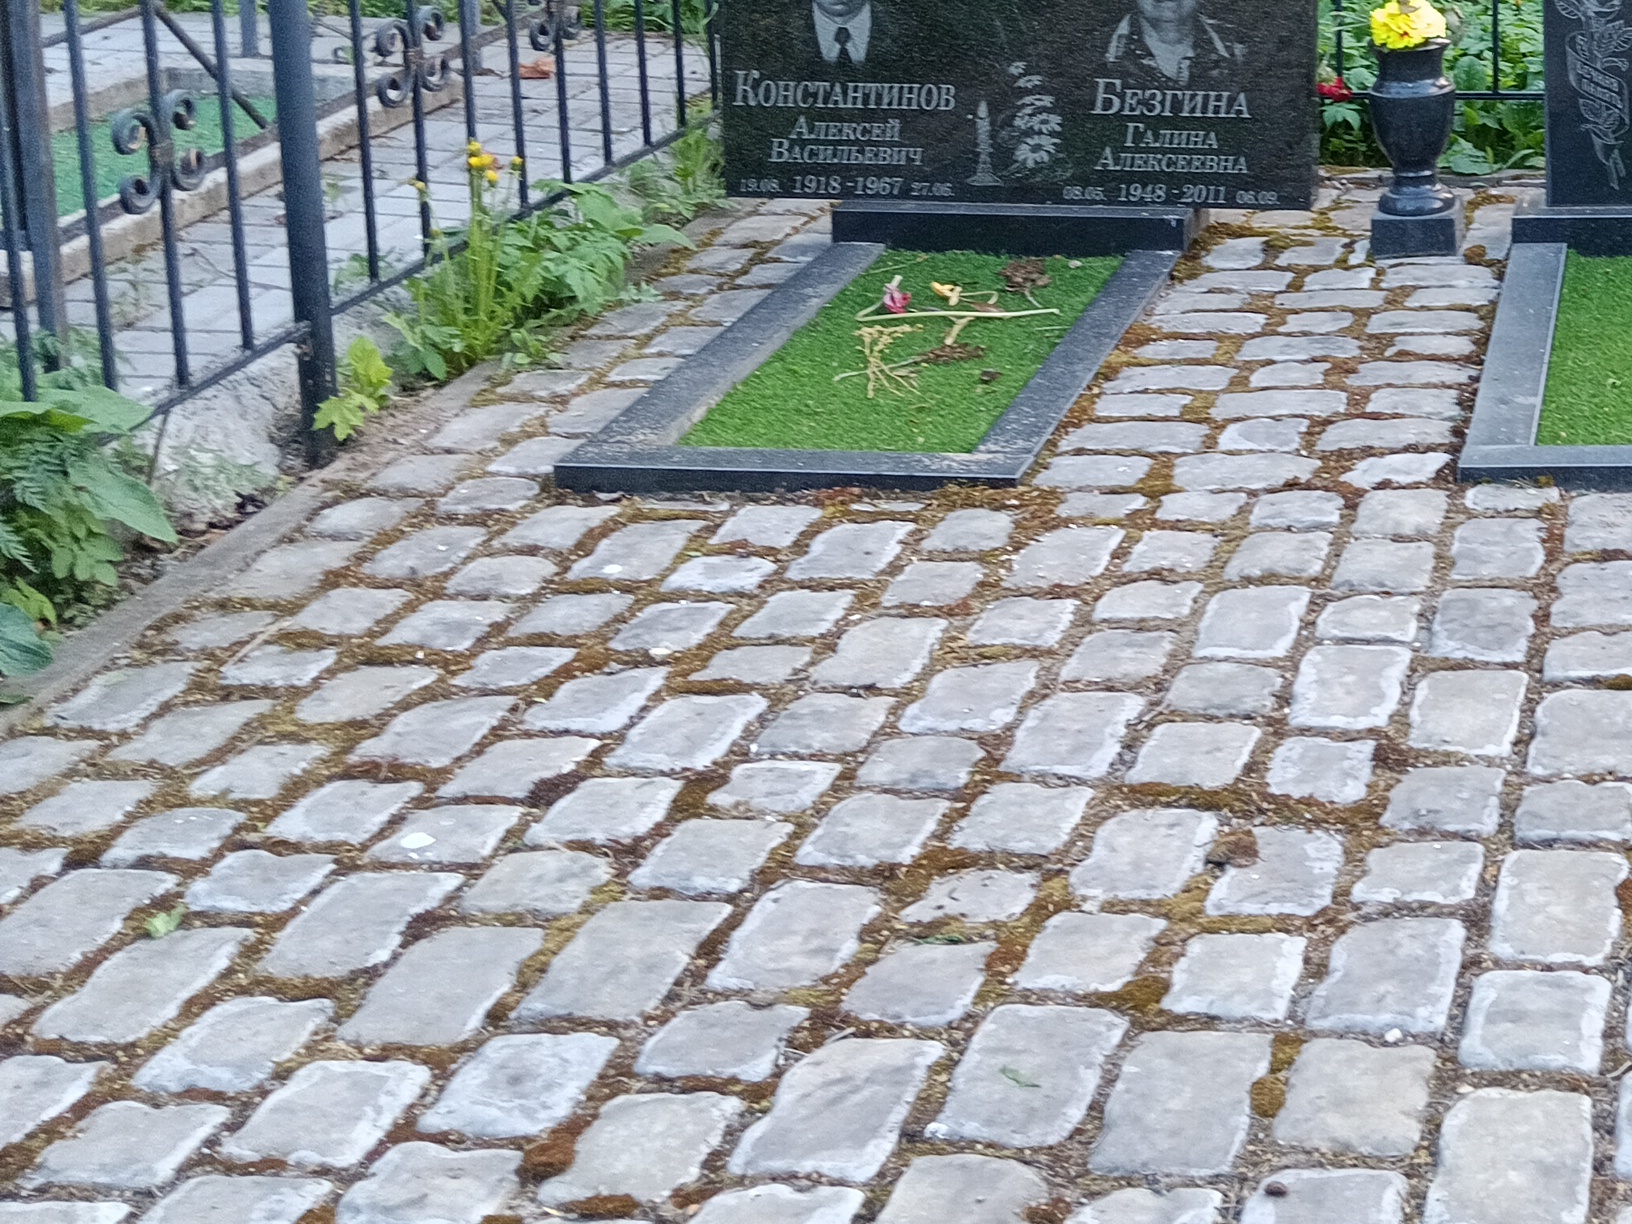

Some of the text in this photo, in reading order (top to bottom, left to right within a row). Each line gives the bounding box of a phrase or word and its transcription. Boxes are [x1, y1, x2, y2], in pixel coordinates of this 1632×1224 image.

[732, 70, 956, 112] КОНСТАНТИНОВ
[1090, 78, 1252, 120] БЕЗГИНА
[789, 116, 901, 142] АЛЕКСЕЙ
[1124, 123, 1218, 150] ГАЛИНА
[768, 138, 923, 167] ВАСИЛЬЕВИЧ
[1094, 150, 1249, 175] АЛЕКСЕЕВНА
